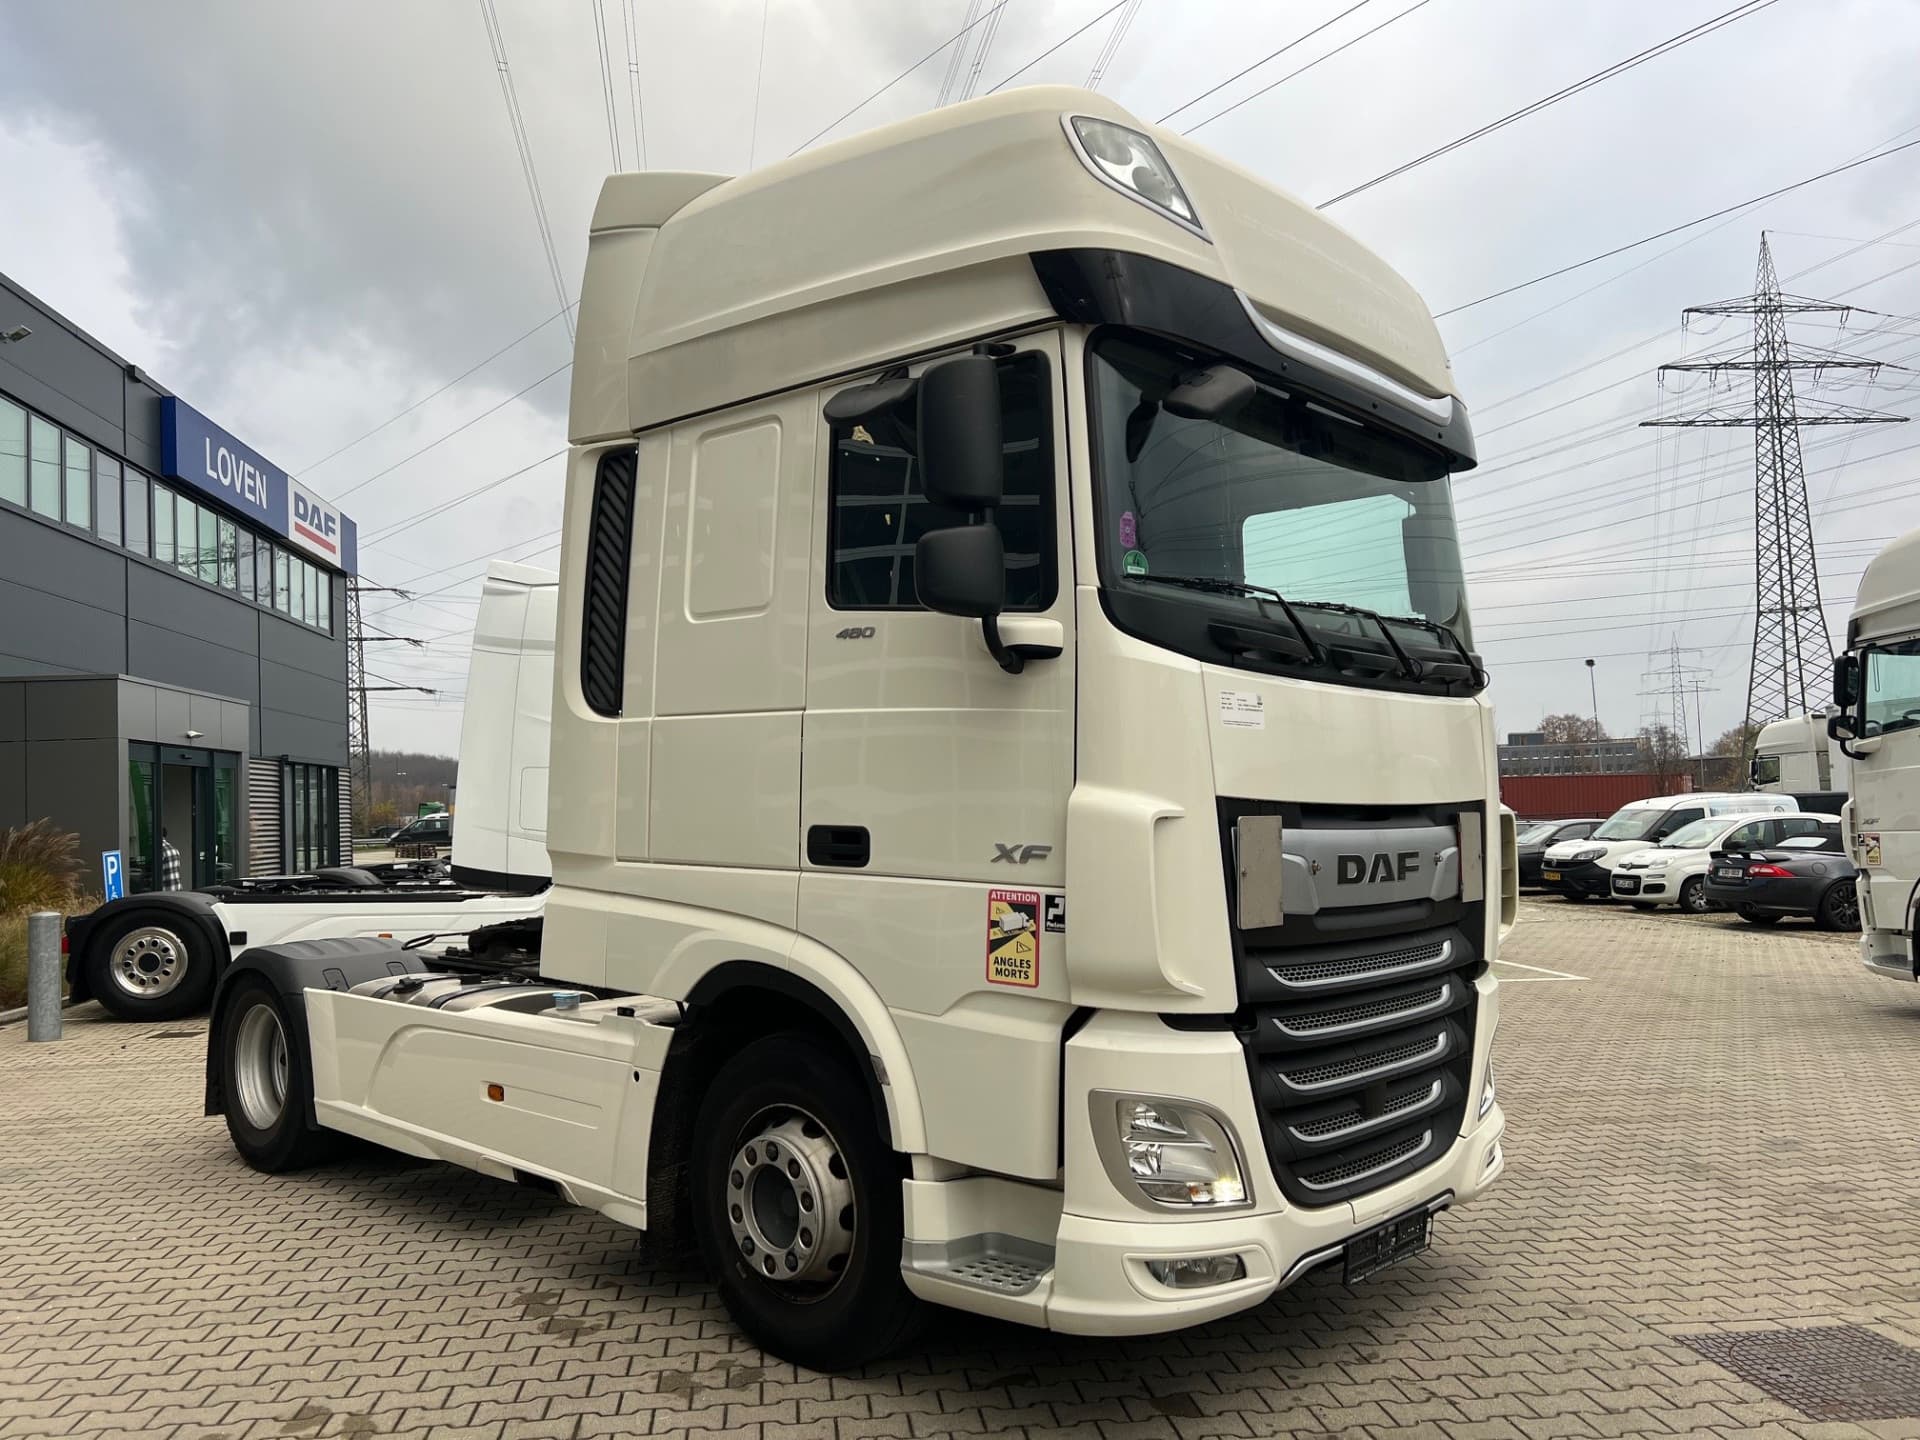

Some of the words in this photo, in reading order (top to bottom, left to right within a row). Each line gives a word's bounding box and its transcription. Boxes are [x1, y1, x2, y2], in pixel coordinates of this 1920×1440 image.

[205, 437, 267, 510] LOVEN
[294, 491, 336, 537] DAF
[835, 626, 876, 640] 480
[990, 843, 1052, 864] XF
[107, 855, 118, 885] P
[1337, 851, 1420, 885] DAF
[991, 891, 1037, 902] ATTENTION
[993, 956, 1031, 969] ANGLES
[995, 967, 1029, 979] MORTS
